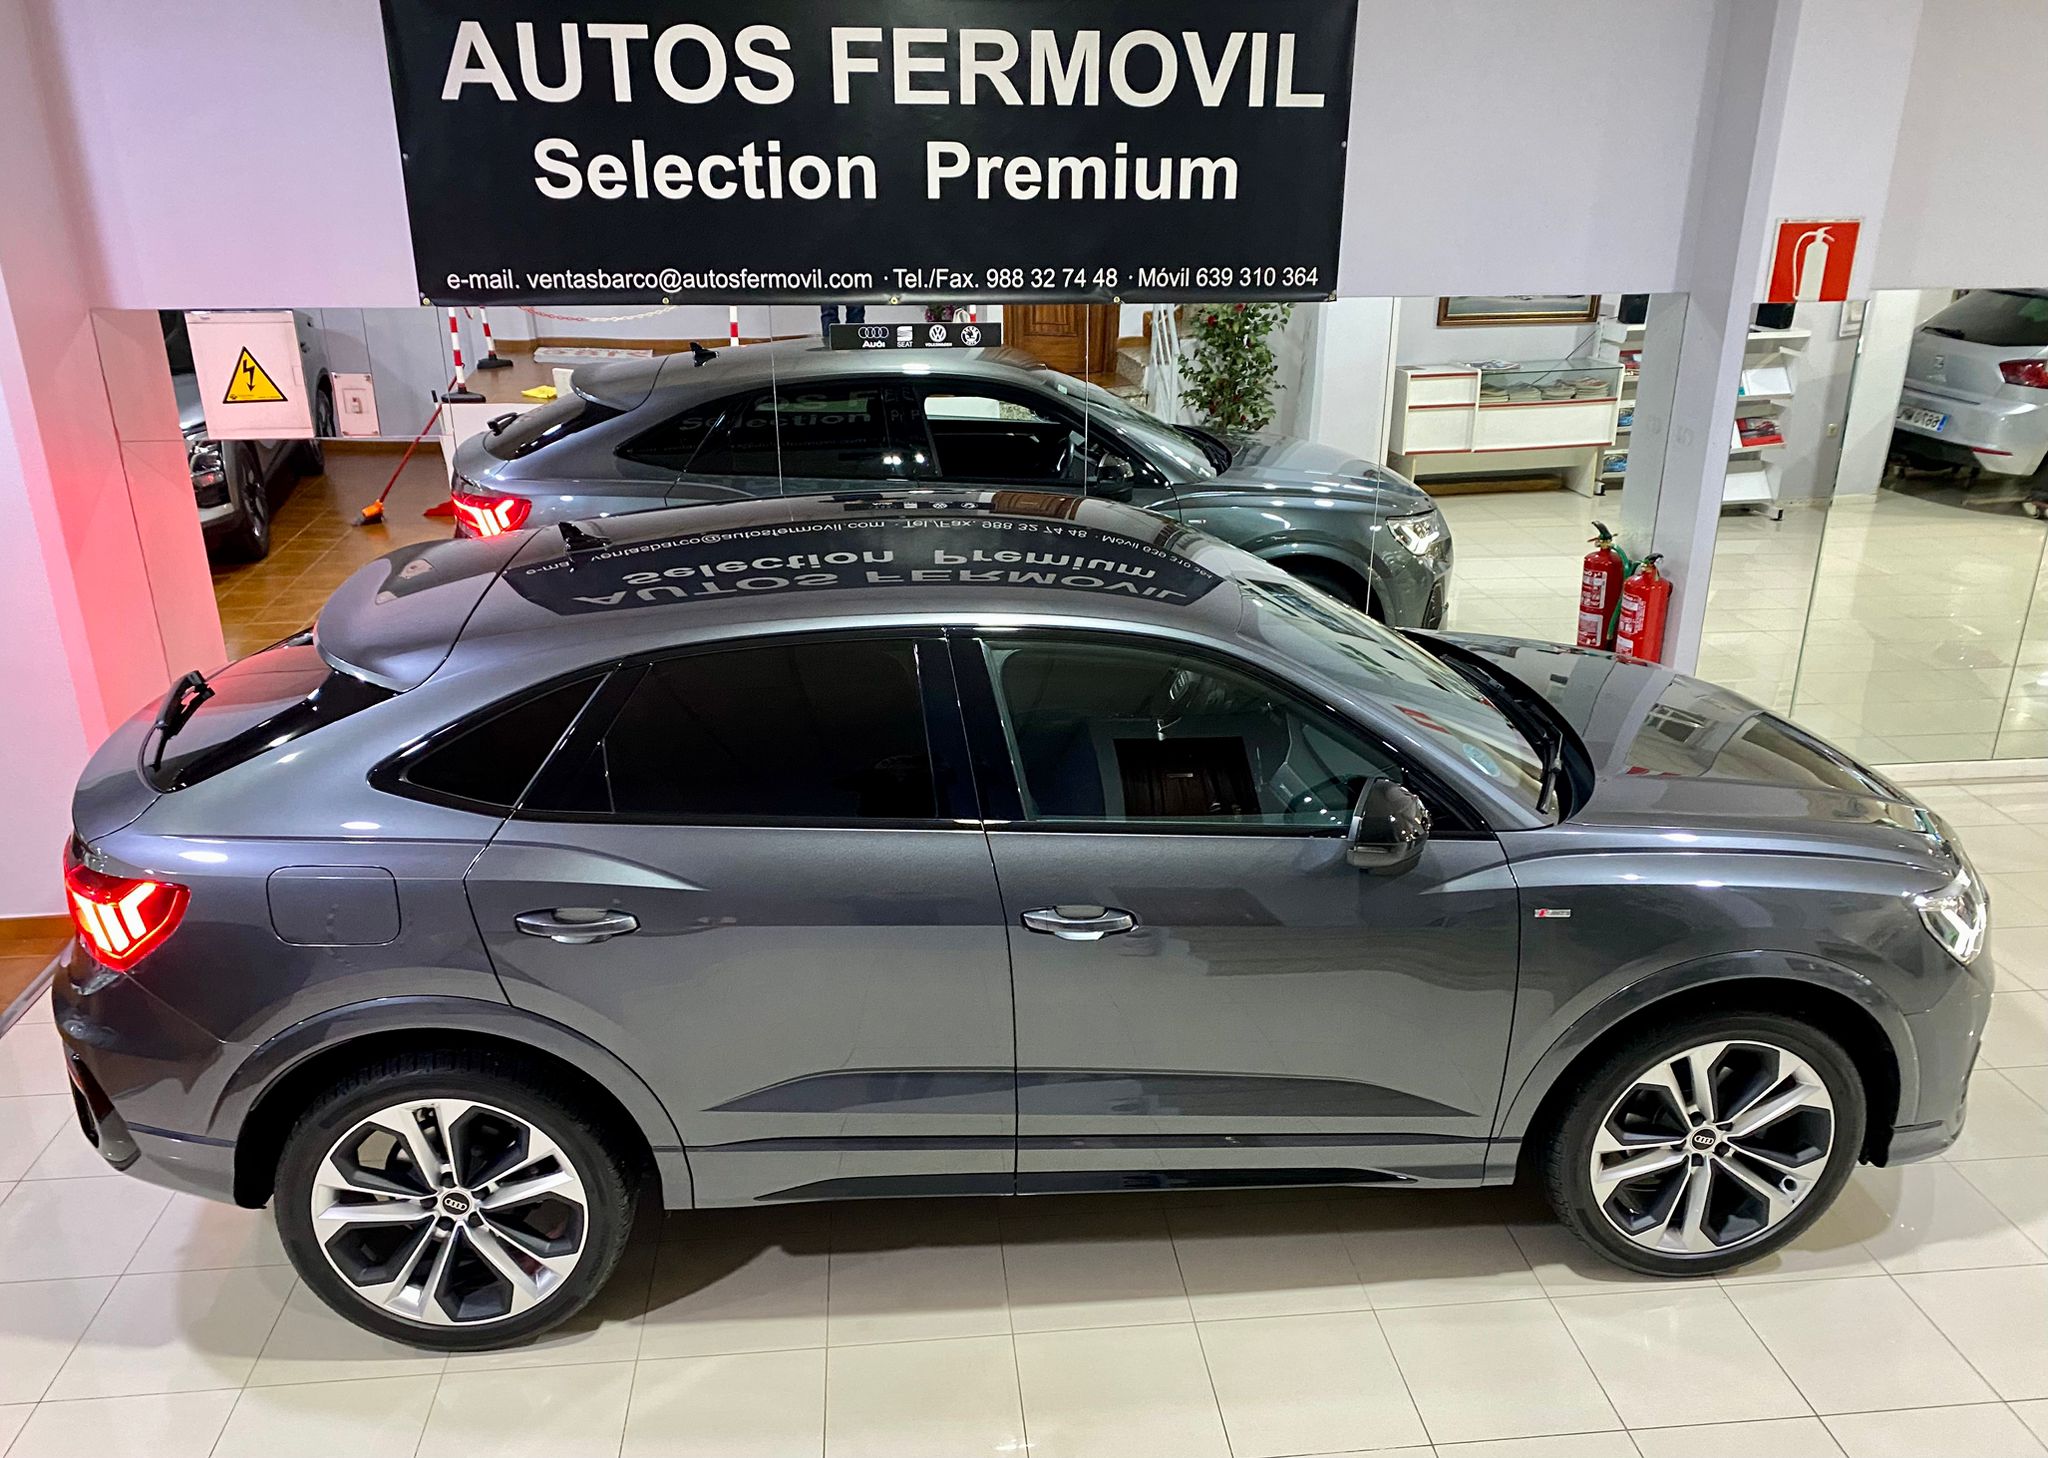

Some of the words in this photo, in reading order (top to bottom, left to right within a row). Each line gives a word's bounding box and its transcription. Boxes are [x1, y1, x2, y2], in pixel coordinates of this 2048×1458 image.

[441, 20, 795, 105] AUTOS
[830, 26, 1326, 108] FERMOVIL
[534, 137, 877, 200] Selection
[926, 140, 1238, 201] Premium
[446, 268, 520, 289] e-mail.
[526, 268, 873, 293] ventasbarco@autosfermovil.com
[986, 268, 1024, 289] 988
[1030, 268, 1056, 288] 32
[1062, 268, 1087, 288] 74
[1092, 267, 1118, 288] 48
[1195, 267, 1233, 287] 639
[1239, 266, 1276, 287] 310
[1281, 266, 1319, 287] 364
